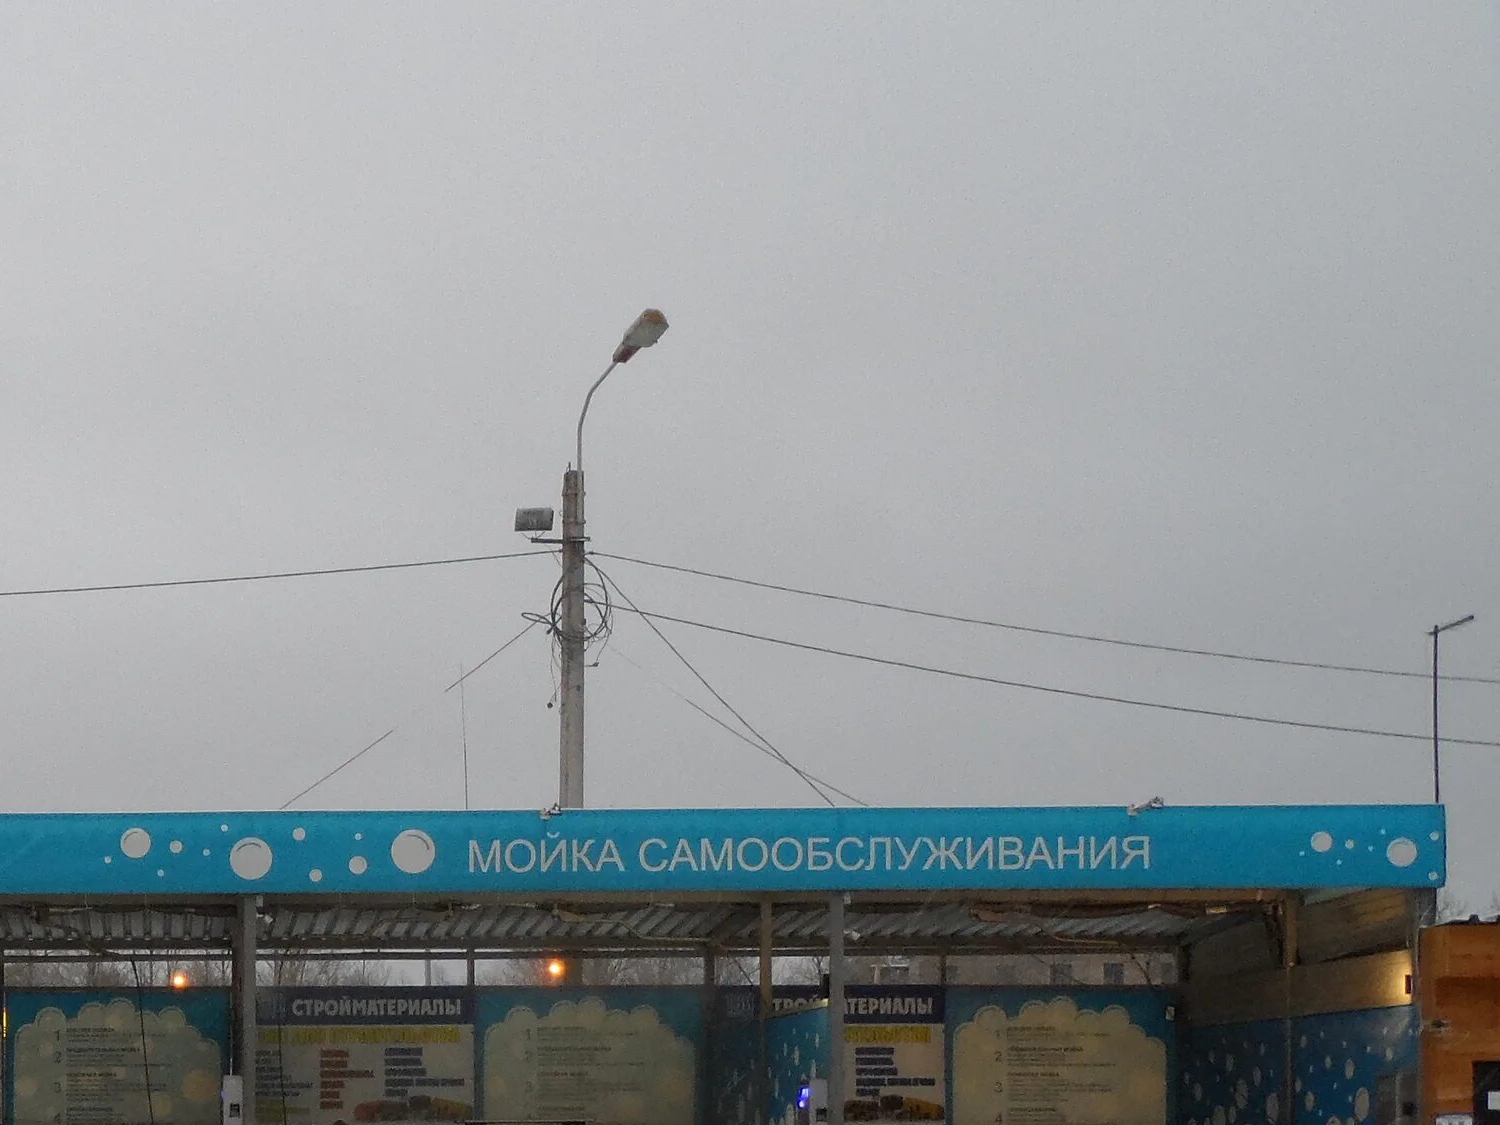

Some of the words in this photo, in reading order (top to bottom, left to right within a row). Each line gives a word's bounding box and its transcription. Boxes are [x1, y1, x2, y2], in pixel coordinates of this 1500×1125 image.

[468, 832, 625, 873] МОЙКА
[638, 835, 1151, 873] САМООБСЛУЖИВАНИЯ
[292, 996, 462, 1016] СТРОЙМАТЕРИАЛЫ
